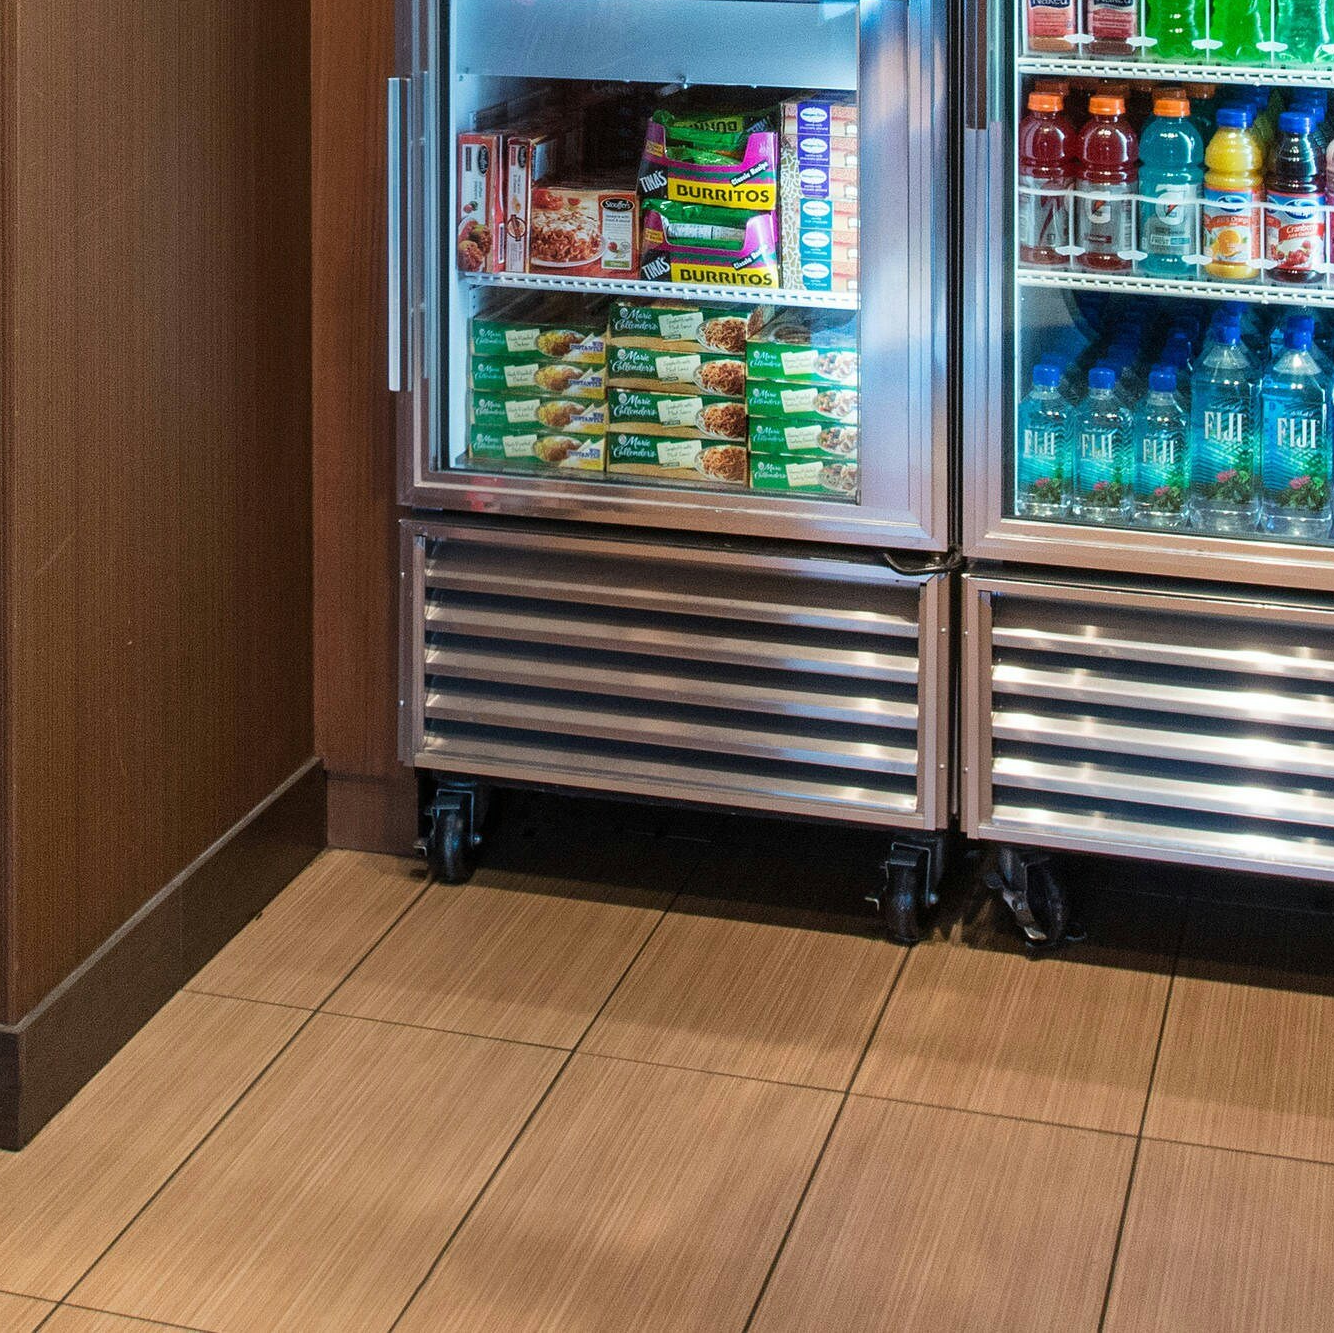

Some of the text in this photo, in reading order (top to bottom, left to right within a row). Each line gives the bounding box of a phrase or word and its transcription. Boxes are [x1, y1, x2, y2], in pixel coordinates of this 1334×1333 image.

[639, 169, 668, 194] TINA'S
[730, 171, 752, 187] Classic
[676, 184, 770, 203] BURRITOS
[641, 256, 671, 282] TINA'S
[733, 254, 753, 270] Classic
[680, 268, 773, 287] BURRITOS
[1204, 410, 1245, 444] FIJI
[1277, 417, 1318, 450] FIJI
[1024, 429, 1056, 457] FIJI
[1080, 431, 1114, 460] FIJI
[1142, 438, 1176, 465] FIJI
